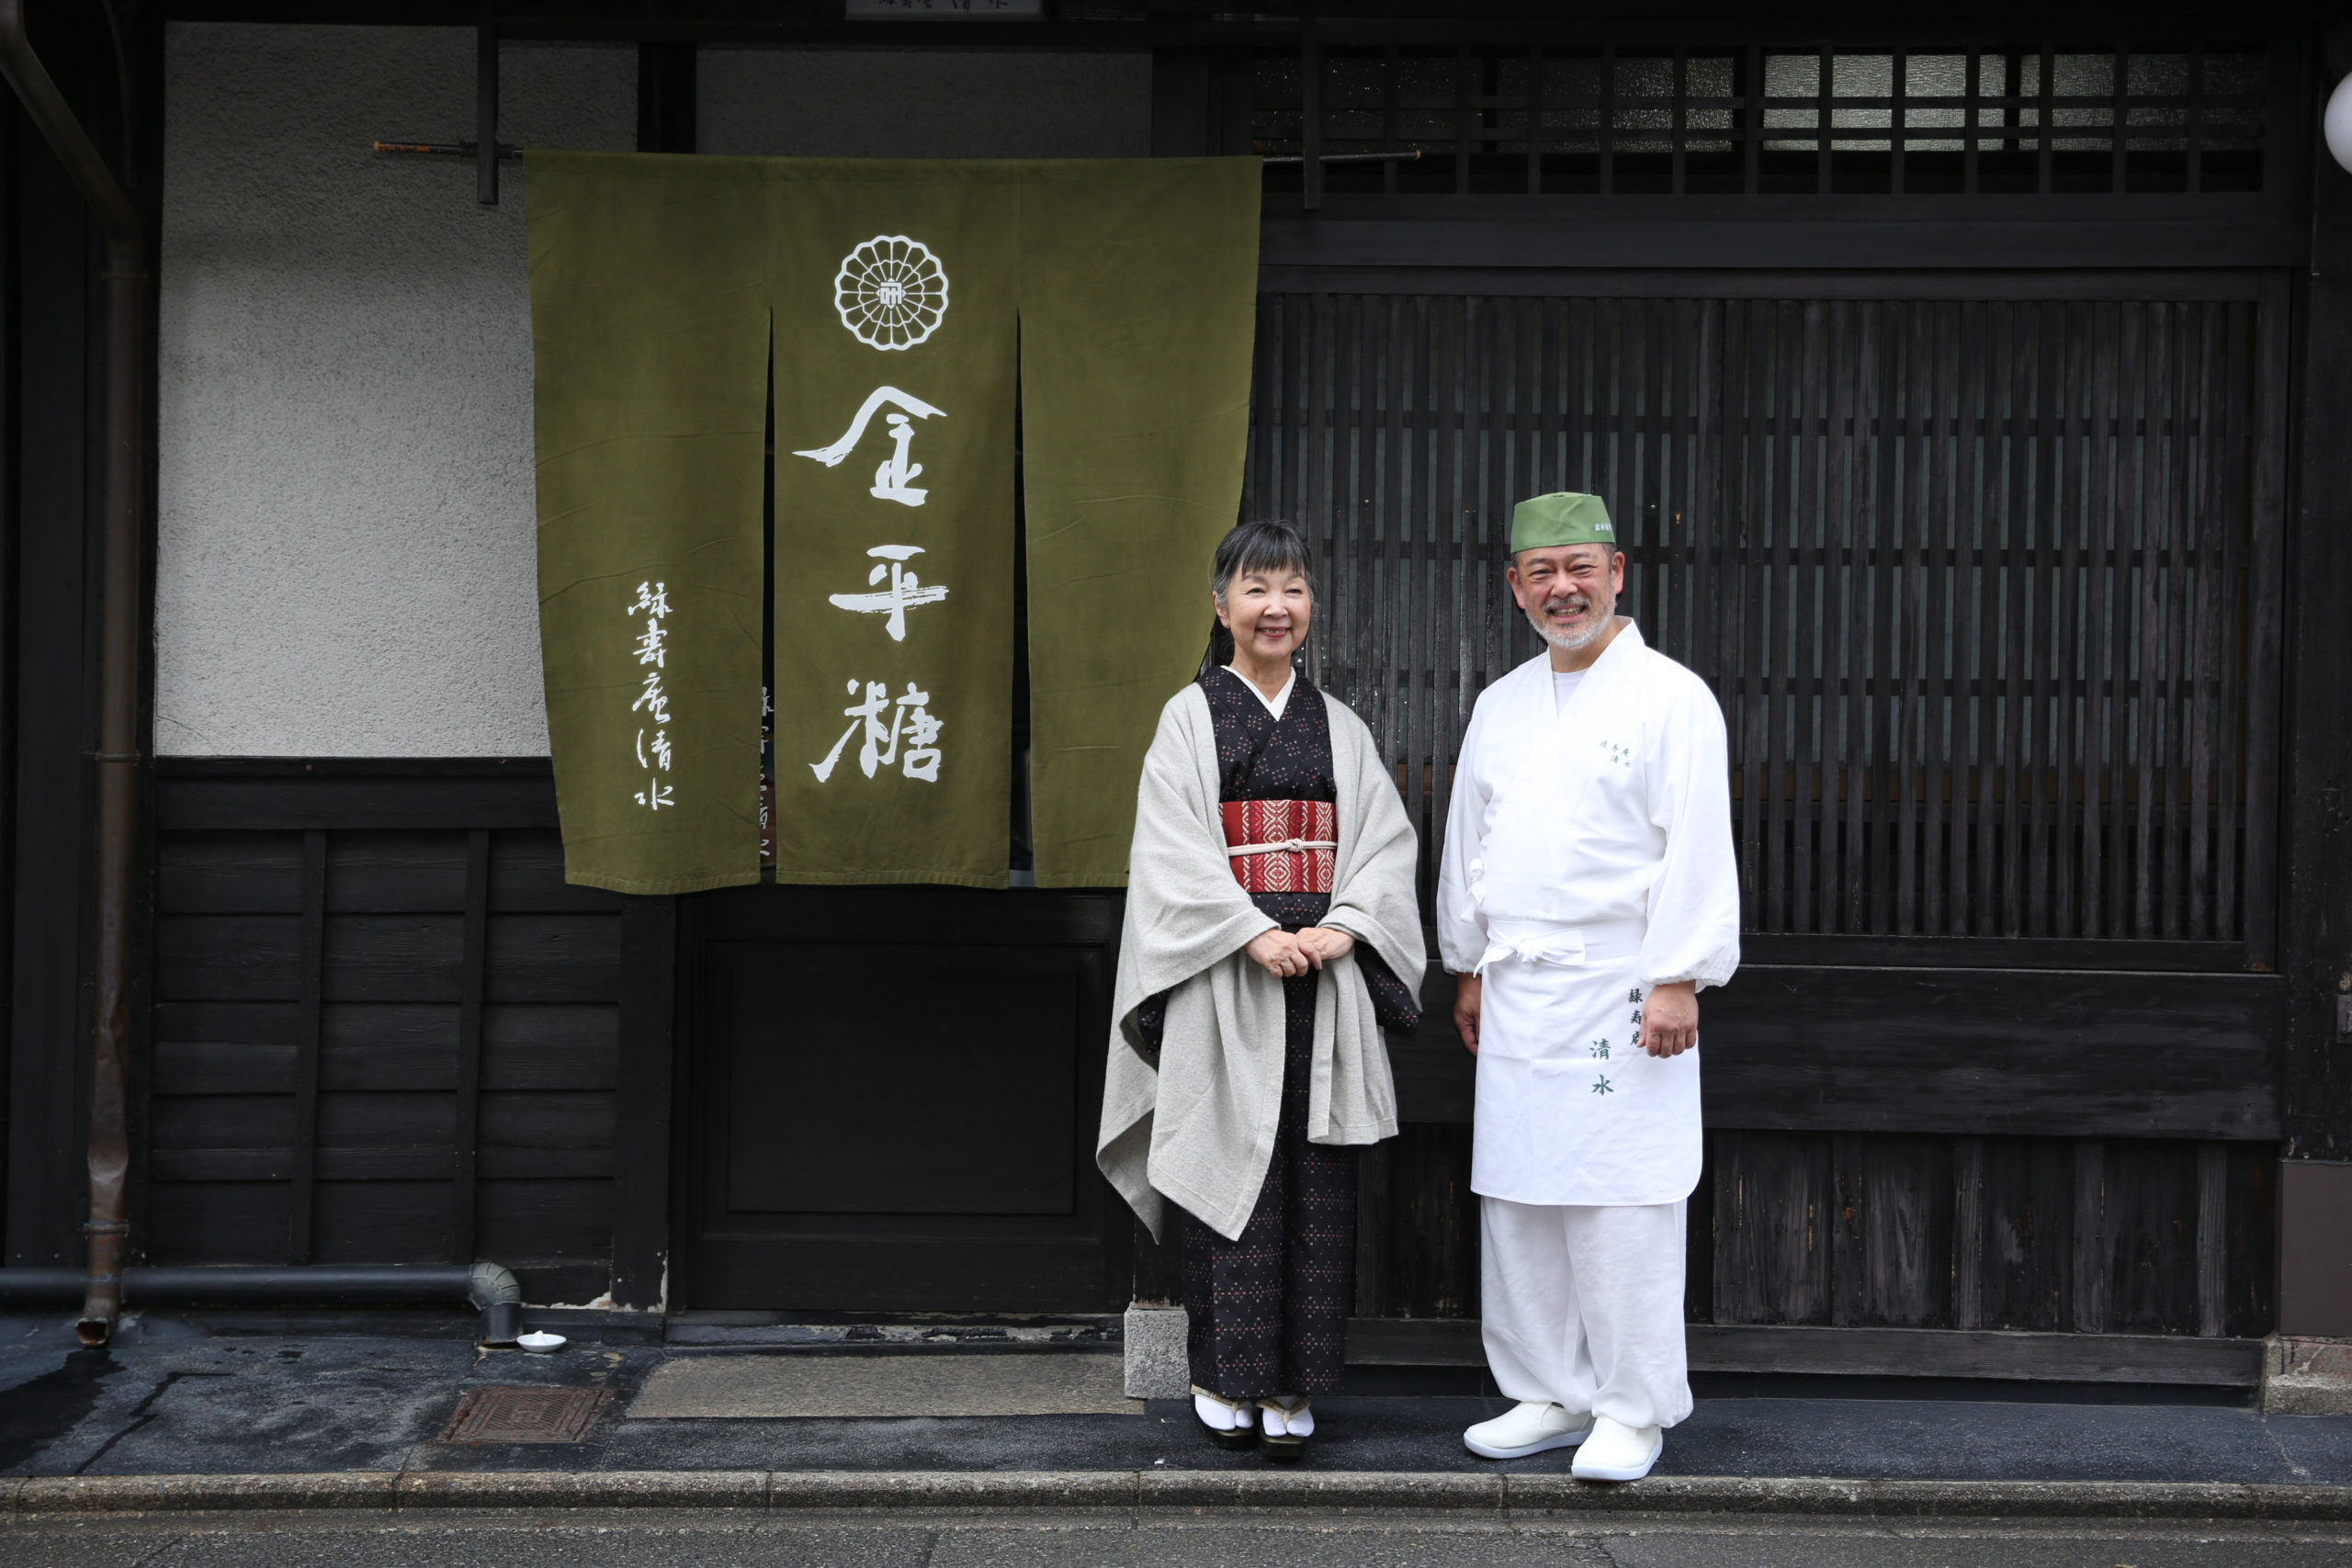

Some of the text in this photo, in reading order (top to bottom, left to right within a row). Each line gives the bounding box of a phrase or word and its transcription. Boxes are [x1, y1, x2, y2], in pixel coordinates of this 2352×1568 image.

[793, 385, 949, 784] 金平糖
[1589, 1038, 1614, 1096] 清水
